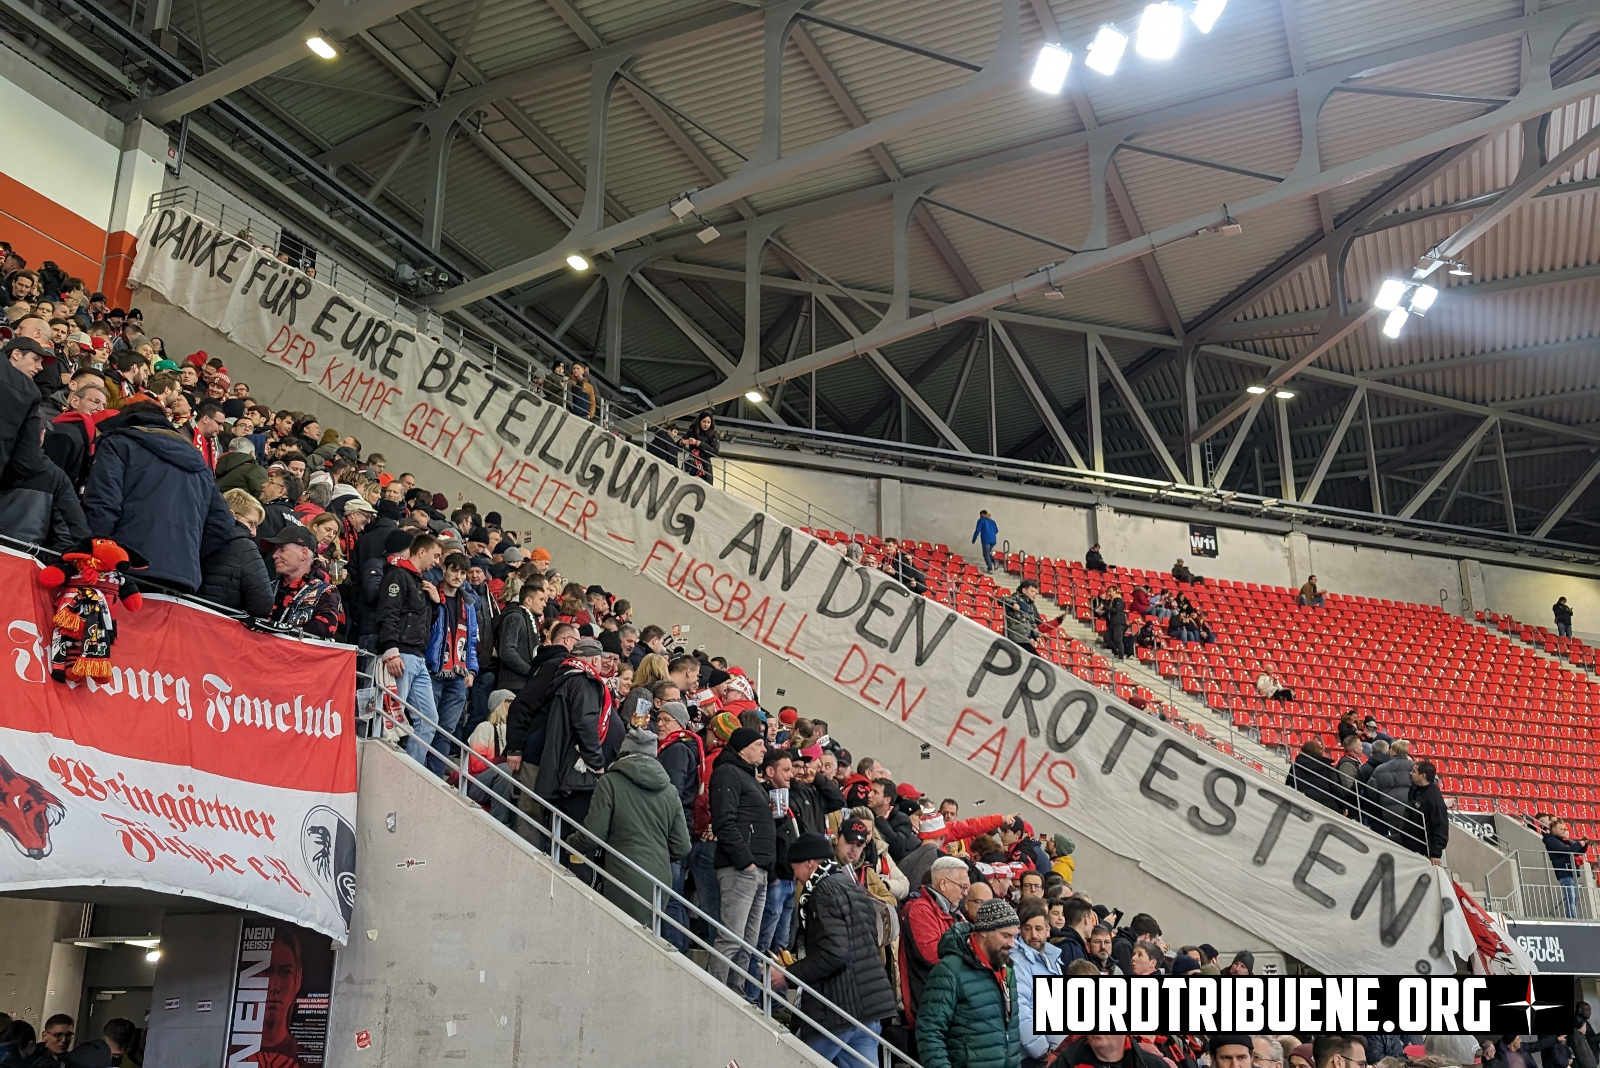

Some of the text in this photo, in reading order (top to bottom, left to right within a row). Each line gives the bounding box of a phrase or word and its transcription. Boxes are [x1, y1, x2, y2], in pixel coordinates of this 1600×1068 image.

[149, 208, 252, 284] DANKE
[241, 259, 313, 326] FÜR
[311, 296, 415, 381] EURE
[418, 347, 706, 545] BETEILIGUNG
[719, 512, 818, 592] AN
[816, 555, 958, 667] DEN
[1190, 535, 1216, 551] W11
[266, 324, 317, 376] DER
[318, 353, 402, 421] KAMPF
[403, 401, 484, 467] GEHT
[485, 447, 599, 541] WEITER
[640, 539, 808, 661] FUSSBALL
[833, 643, 927, 722] DEN
[945, 707, 1077, 809] FANS
[202, 673, 343, 740] Fanclub
[48, 753, 278, 842] Weingärtner
[243, 941, 274, 950] HEISST
[244, 927, 275, 941] NEIN
[1516, 935, 1560, 952] GET IN
[1525, 948, 1565, 962] OUCH
[228, 950, 272, 1068] NEIN
